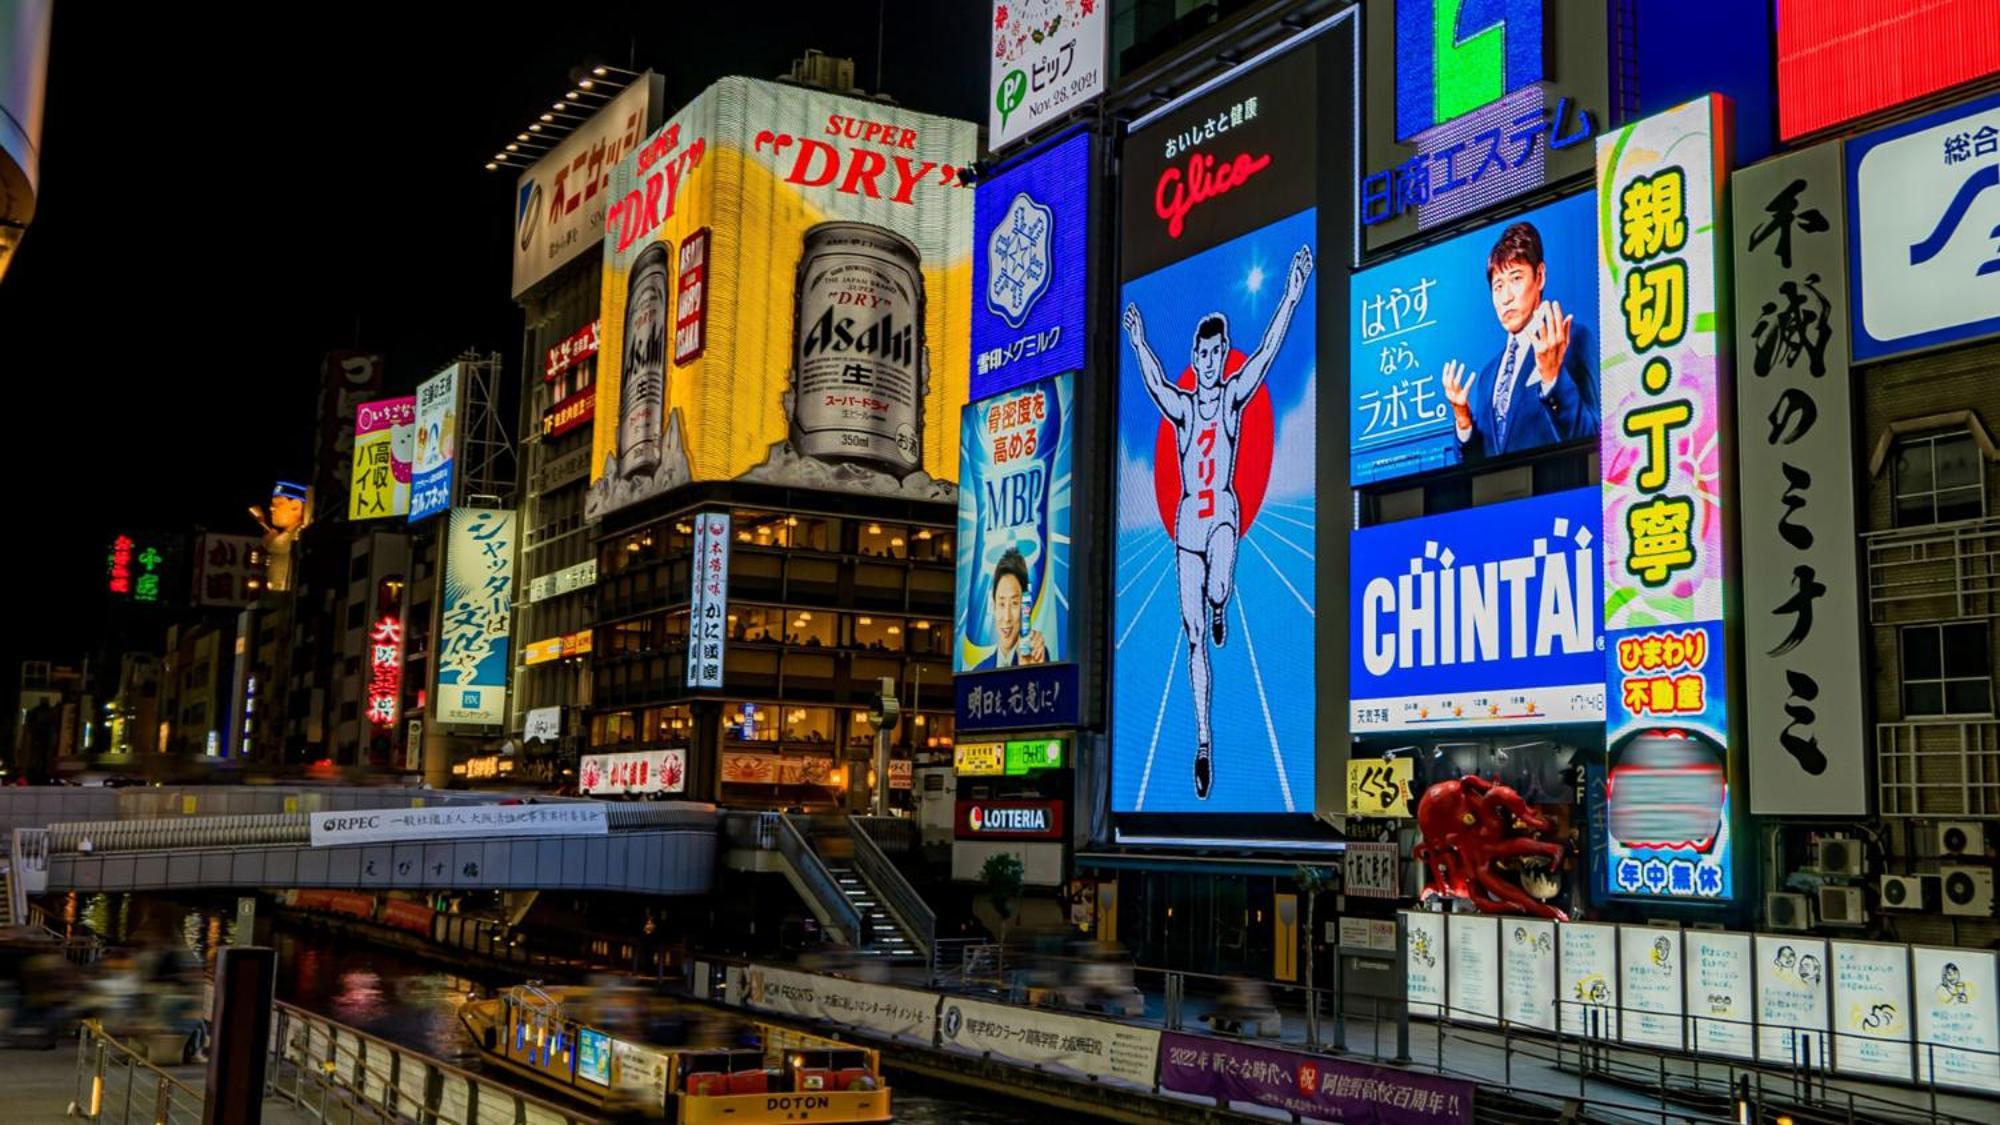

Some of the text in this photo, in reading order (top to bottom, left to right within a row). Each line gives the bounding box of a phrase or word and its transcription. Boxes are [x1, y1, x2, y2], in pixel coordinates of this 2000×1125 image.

[1032, 38, 1077, 93] ピップ
[1070, 68, 1097, 96] 2021
[637, 121, 682, 177] SUPER
[826, 113, 918, 150] SUPER
[1165, 96, 1259, 159] おいしさと健康
[1361, 96, 1593, 225] 日商エステム
[1361, 277, 1437, 339] はやす
[803, 304, 912, 368] Asahi
[976, 325, 1061, 376] 雪印メグミルク
[1380, 341, 1420, 375] なら、
[842, 363, 873, 387] 生
[1621, 166, 1697, 588] 親切・丁寧
[372, 402, 416, 420] いちごな
[825, 395, 890, 412] スーパードライ
[988, 389, 1045, 434] 骨密度を
[1357, 375, 1448, 435] ラボモ。
[841, 433, 869, 449] 350ml
[993, 428, 1037, 465] 高める
[355, 443, 374, 515] バイト
[370, 441, 391, 513] 高収入
[1196, 421, 1218, 519] グリコ
[1748, 179, 1832, 776] 不滅のミナミ
[986, 468, 1042, 531] MBP
[467, 513, 512, 634] シャッターは
[1362, 518, 1594, 677] CHINTAI
[703, 602, 721, 681] かに道楽
[1619, 631, 1706, 672] ひまわり
[1358, 708, 1389, 723] 天気予報
[1623, 675, 1703, 714] 不動産
[983, 808, 1045, 829] LOTTERIA
[1618, 858, 1723, 895] 年中無休
[767, 1097, 829, 1111] DOTON
